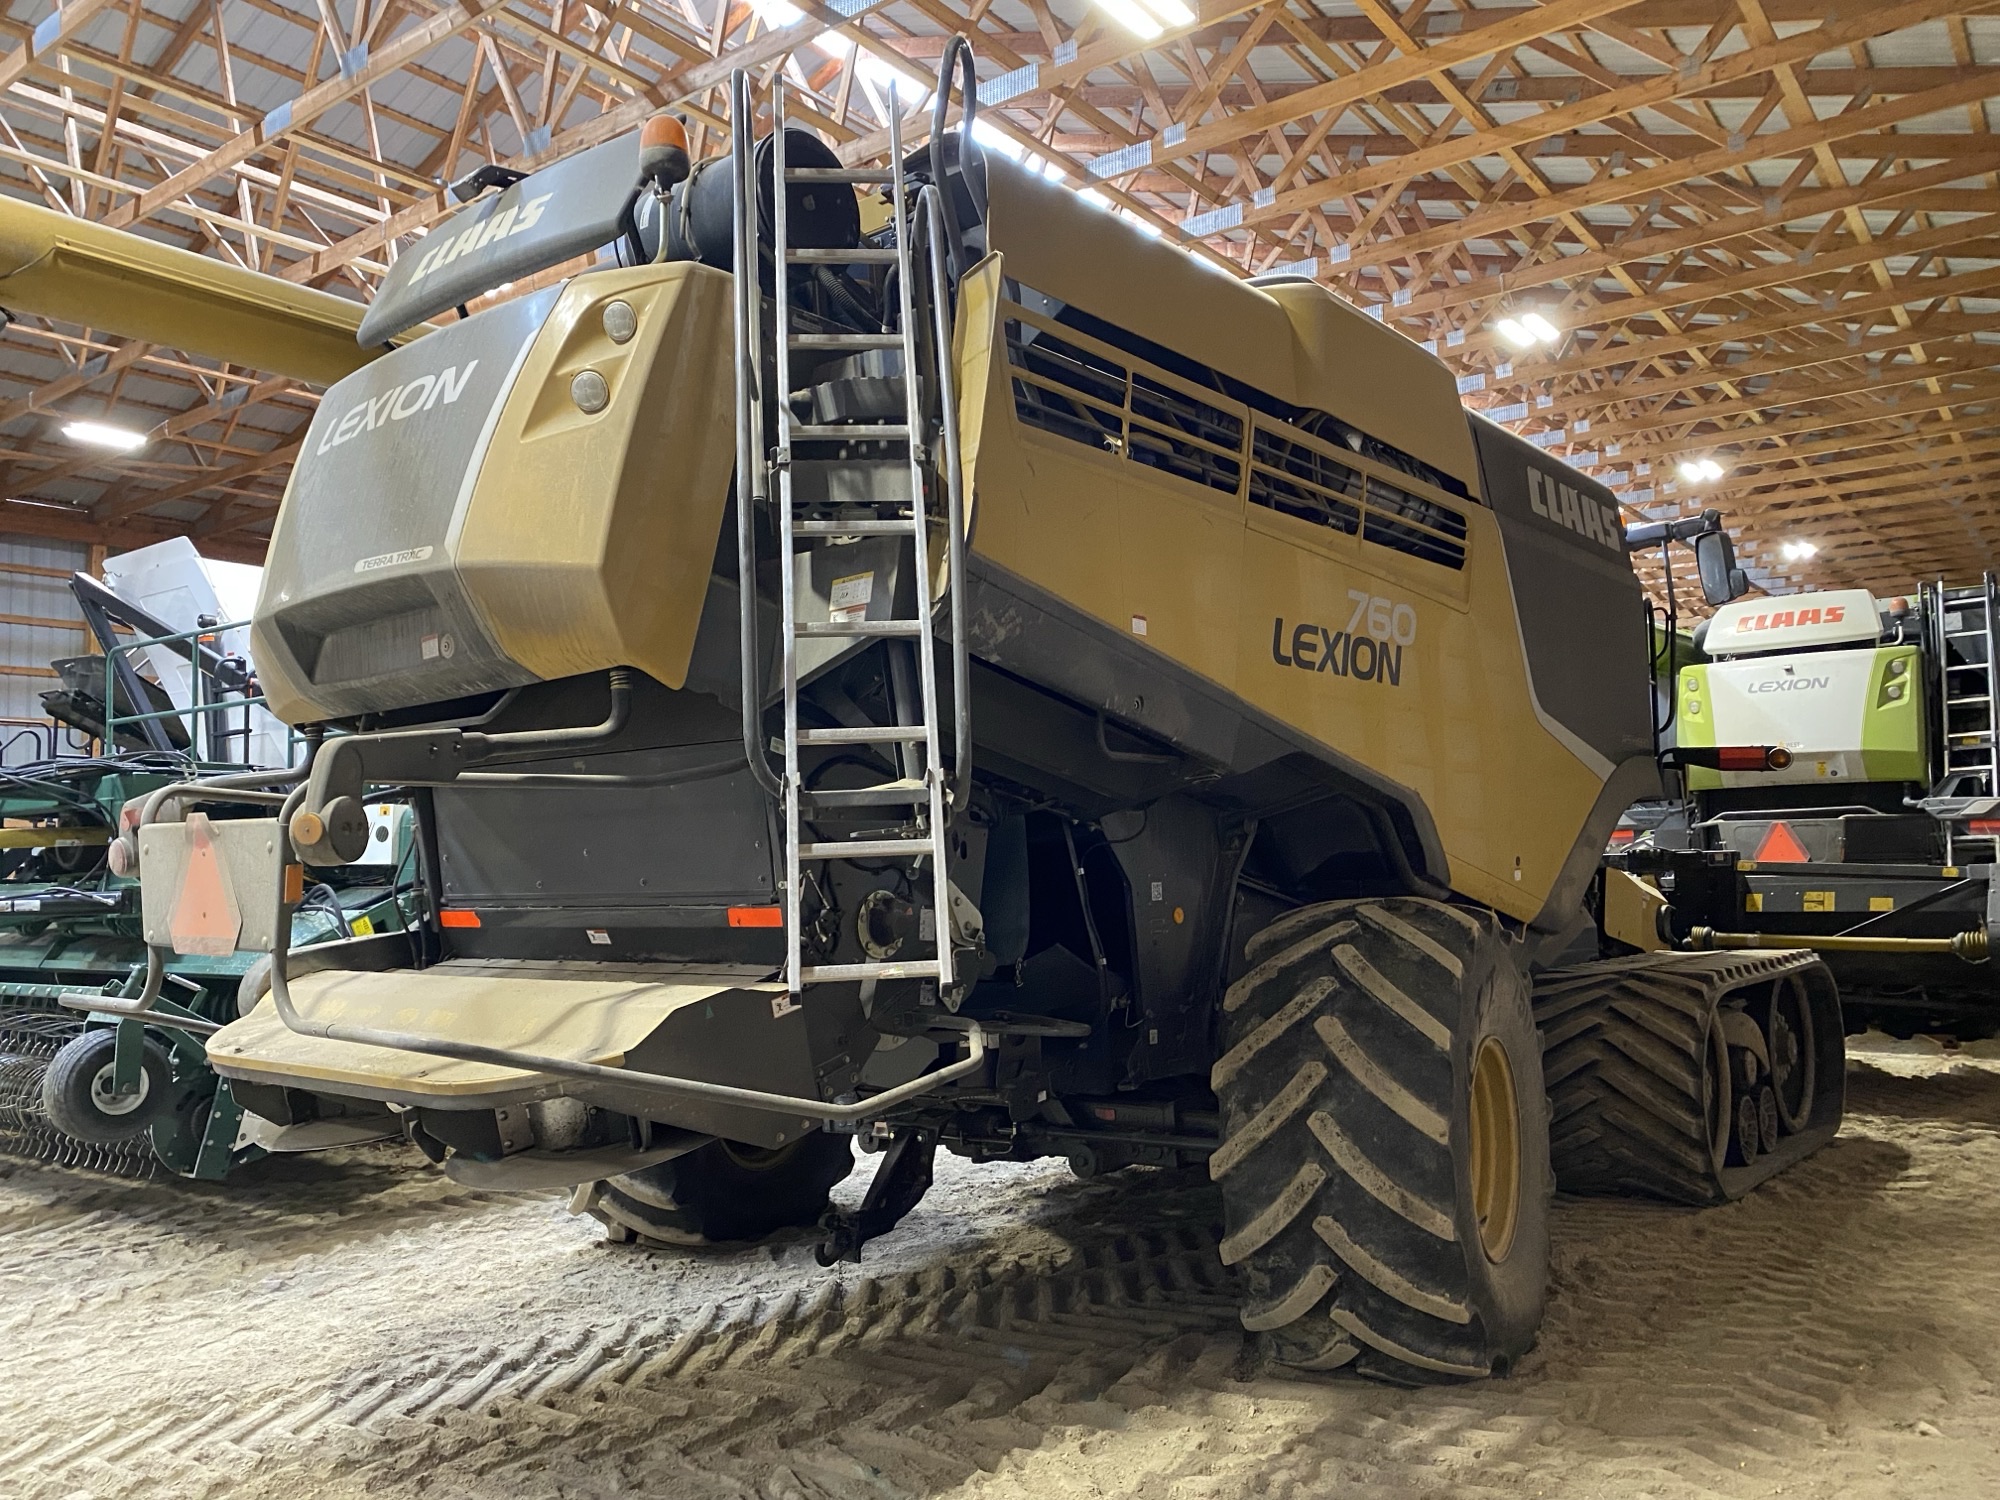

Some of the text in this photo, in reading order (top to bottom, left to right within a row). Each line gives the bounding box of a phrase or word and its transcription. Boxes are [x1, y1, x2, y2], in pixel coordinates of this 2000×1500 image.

[407, 192, 554, 287] CLAAS
[316, 359, 479, 456] LEXION
[1527, 466, 1621, 553] CLAAS
[362, 555, 394, 570] TERRA
[1345, 588, 1417, 646] 760
[1736, 606, 1845, 633] CLAAS
[1273, 617, 1402, 687] LEXION
[1747, 676, 1830, 694] LEXION
